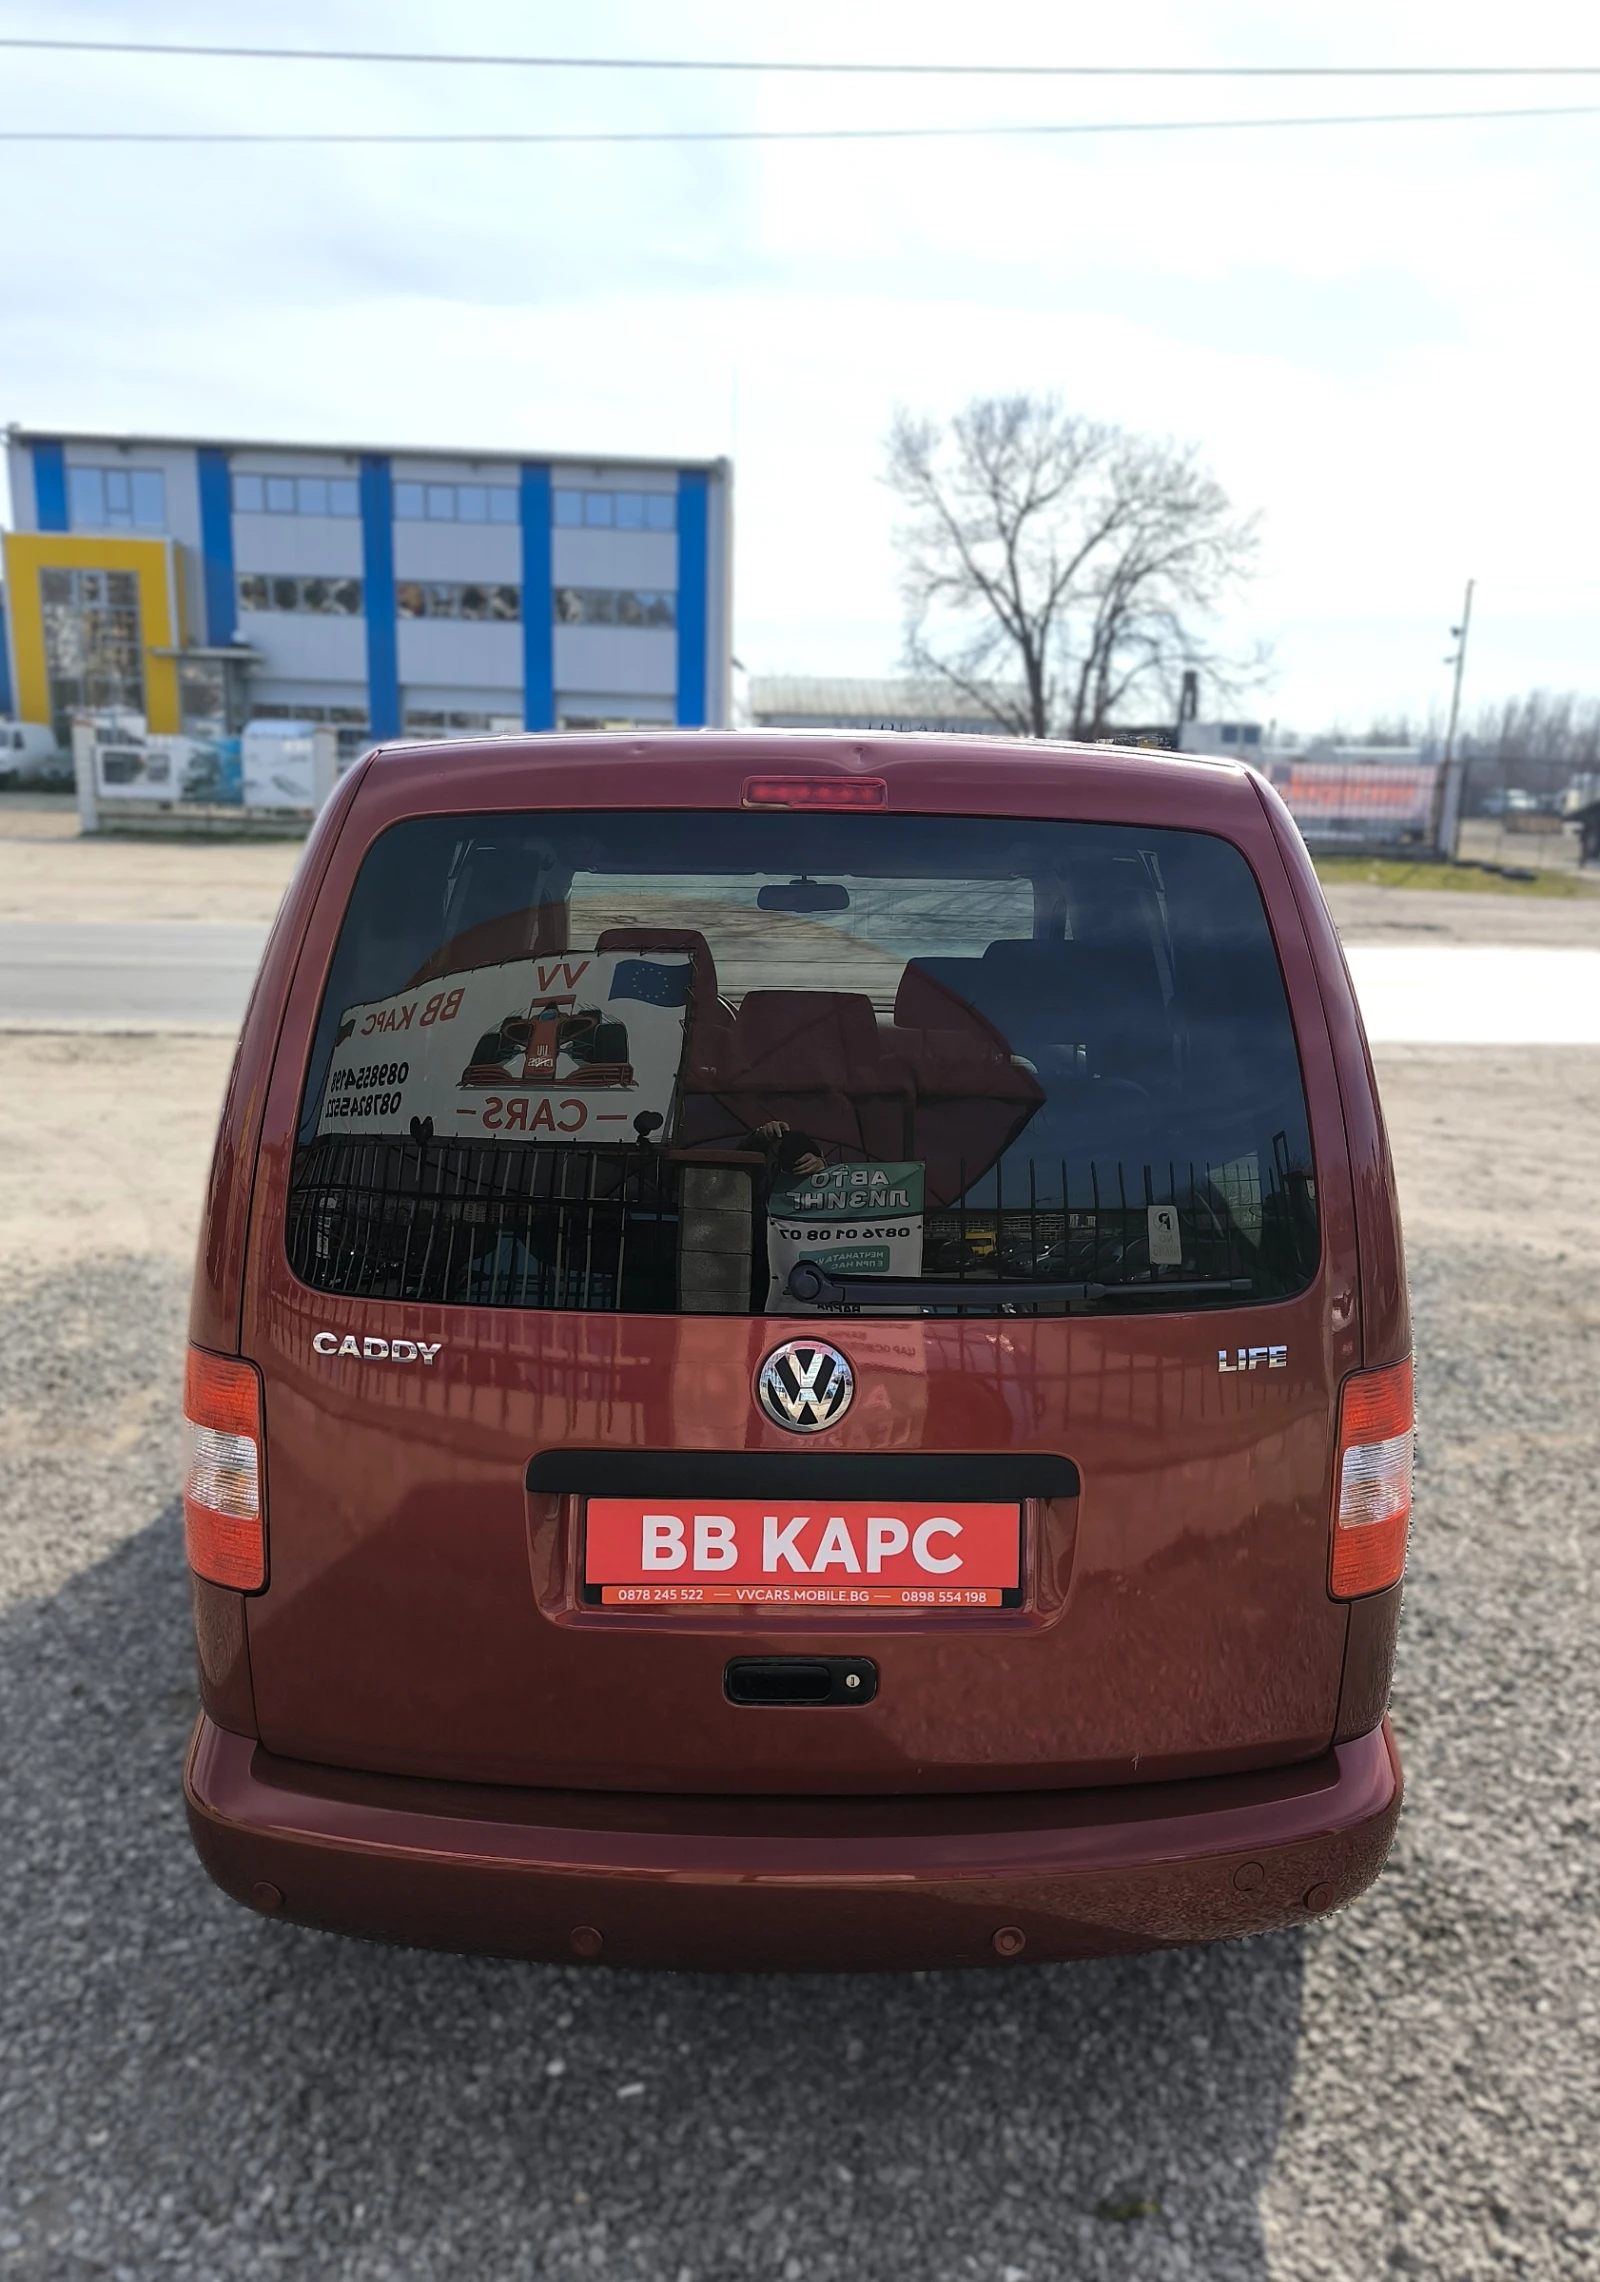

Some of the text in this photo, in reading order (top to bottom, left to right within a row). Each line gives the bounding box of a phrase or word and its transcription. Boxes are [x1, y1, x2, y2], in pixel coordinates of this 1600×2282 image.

[312, 1331, 443, 1365] CADDY
[1217, 1344, 1288, 1373] LIFE
[641, 1515, 964, 1574] ВВ КАРС
[618, 1588, 987, 1603] 0878 245 522 VVCARS.MOBILE.BG 0898 554 198
